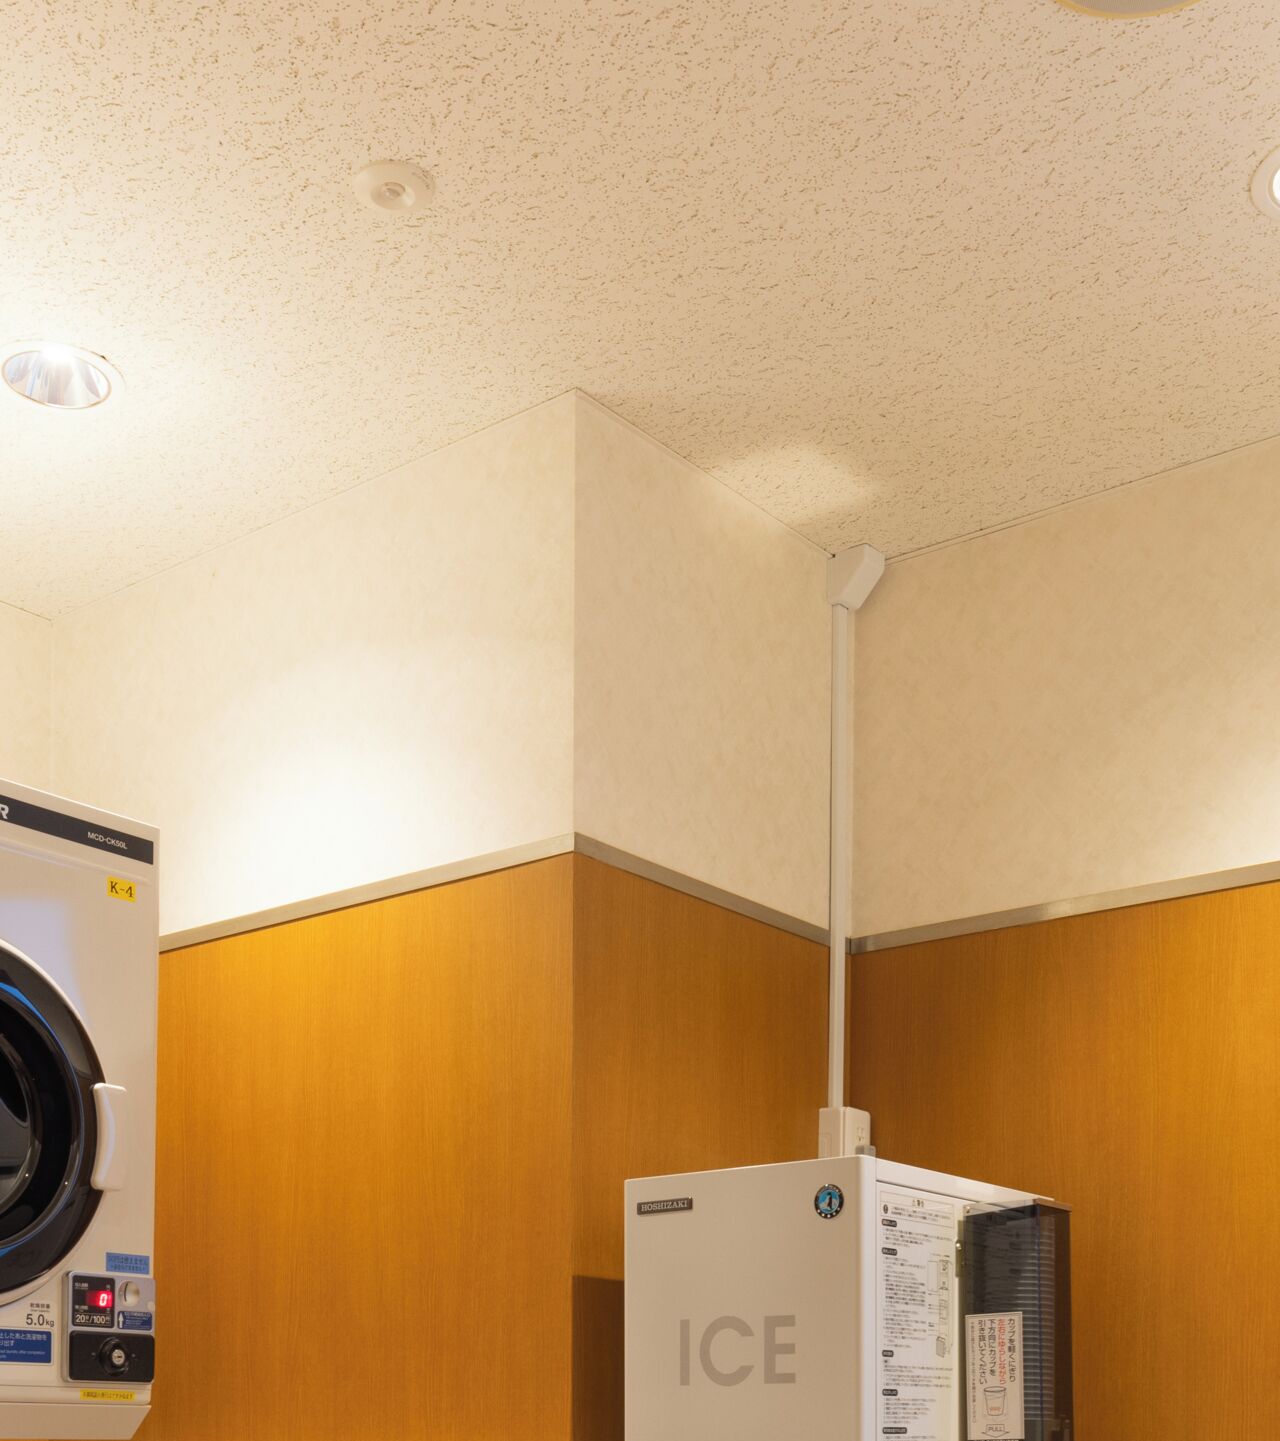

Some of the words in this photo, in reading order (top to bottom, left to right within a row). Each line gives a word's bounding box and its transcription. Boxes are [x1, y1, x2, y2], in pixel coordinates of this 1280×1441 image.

[88, 831, 128, 850] MCD-CK50L
[110, 882, 134, 899] K-4
[641, 1200, 688, 1212] HOSHIZAKI
[99, 1293, 108, 1307] 0
[679, 1314, 797, 1387] ICE
[978, 1320, 988, 1385] 引き抜いてください
[988, 1319, 997, 1376] 下方向にカップを
